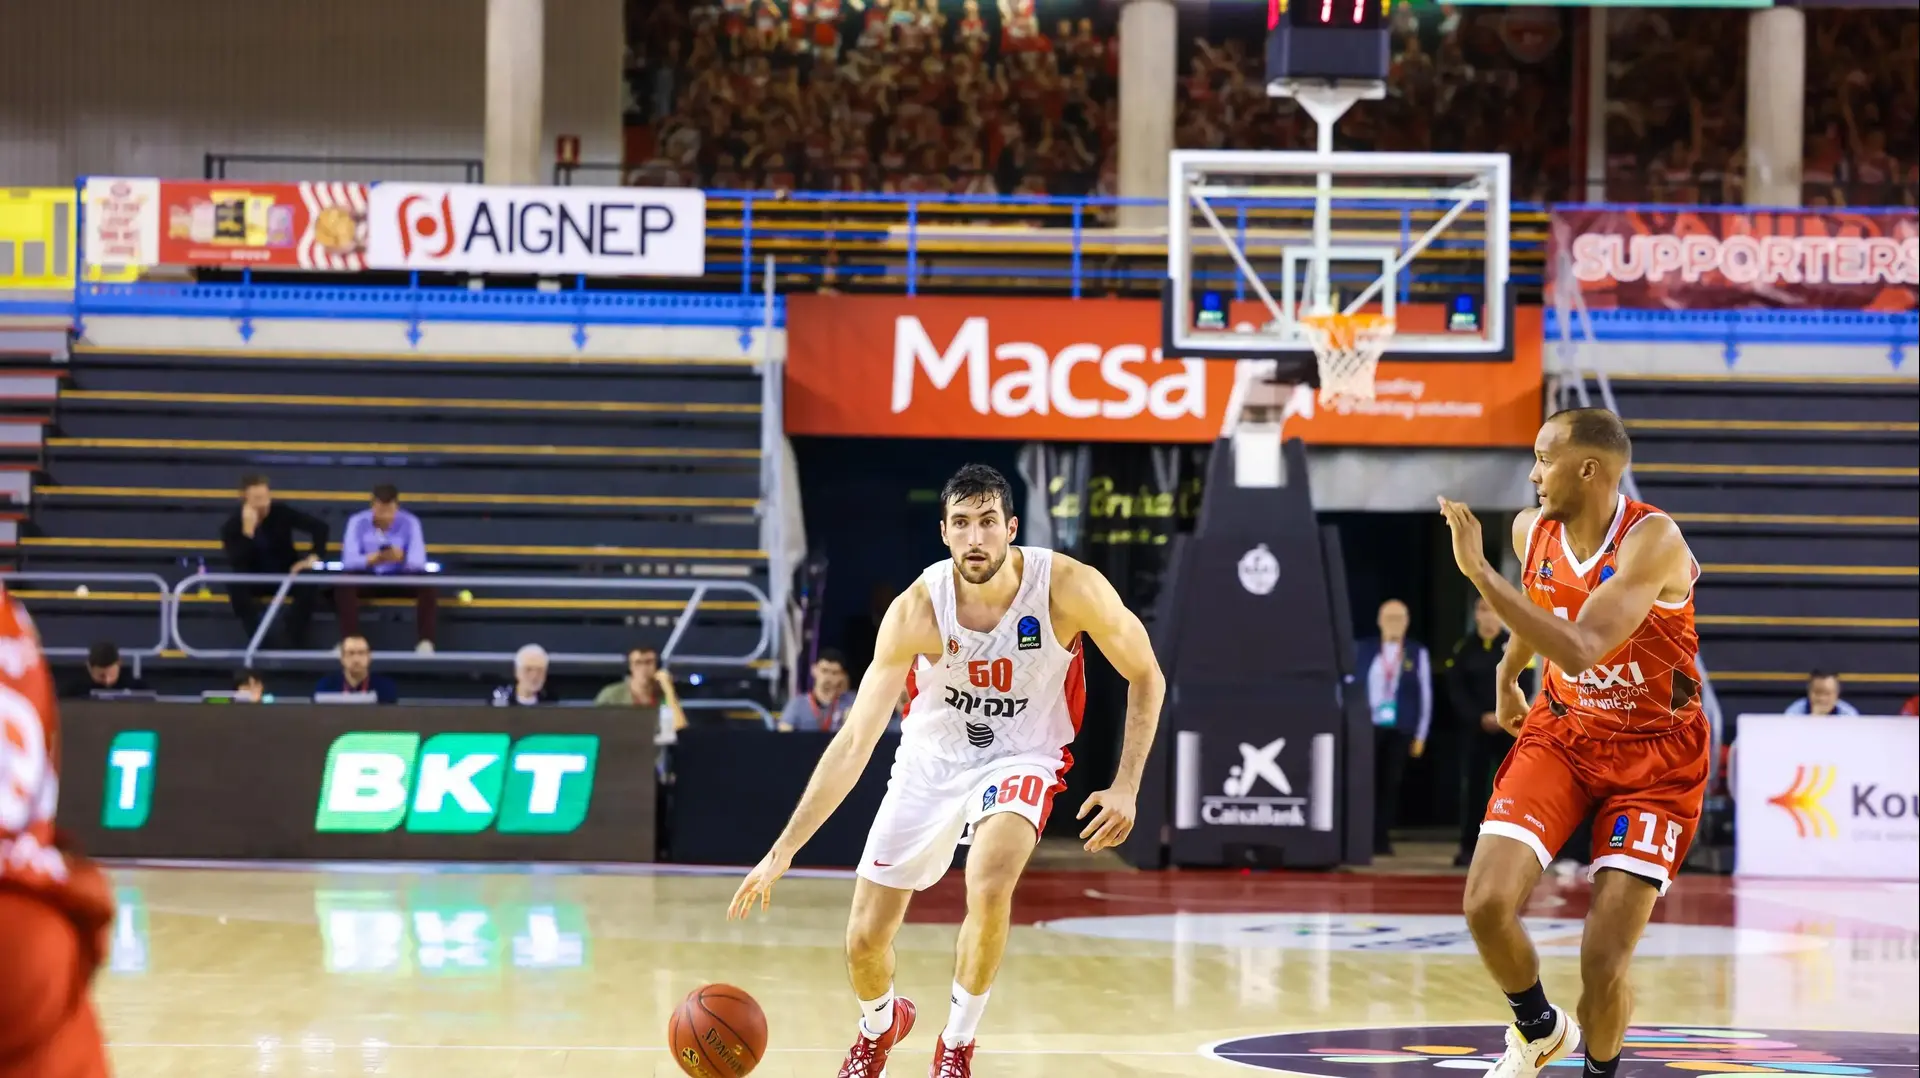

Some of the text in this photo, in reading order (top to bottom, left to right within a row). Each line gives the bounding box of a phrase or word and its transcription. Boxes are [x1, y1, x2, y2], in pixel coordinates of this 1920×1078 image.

[462, 200, 675, 257] AIGNEP
[891, 315, 1207, 420] Macsa
[967, 657, 1013, 694] 50
[1561, 660, 1646, 691] AXI
[110, 749, 152, 810] T
[326, 752, 587, 814] BKT
[997, 774, 1044, 807] 50
[1632, 812, 1683, 863] 19
